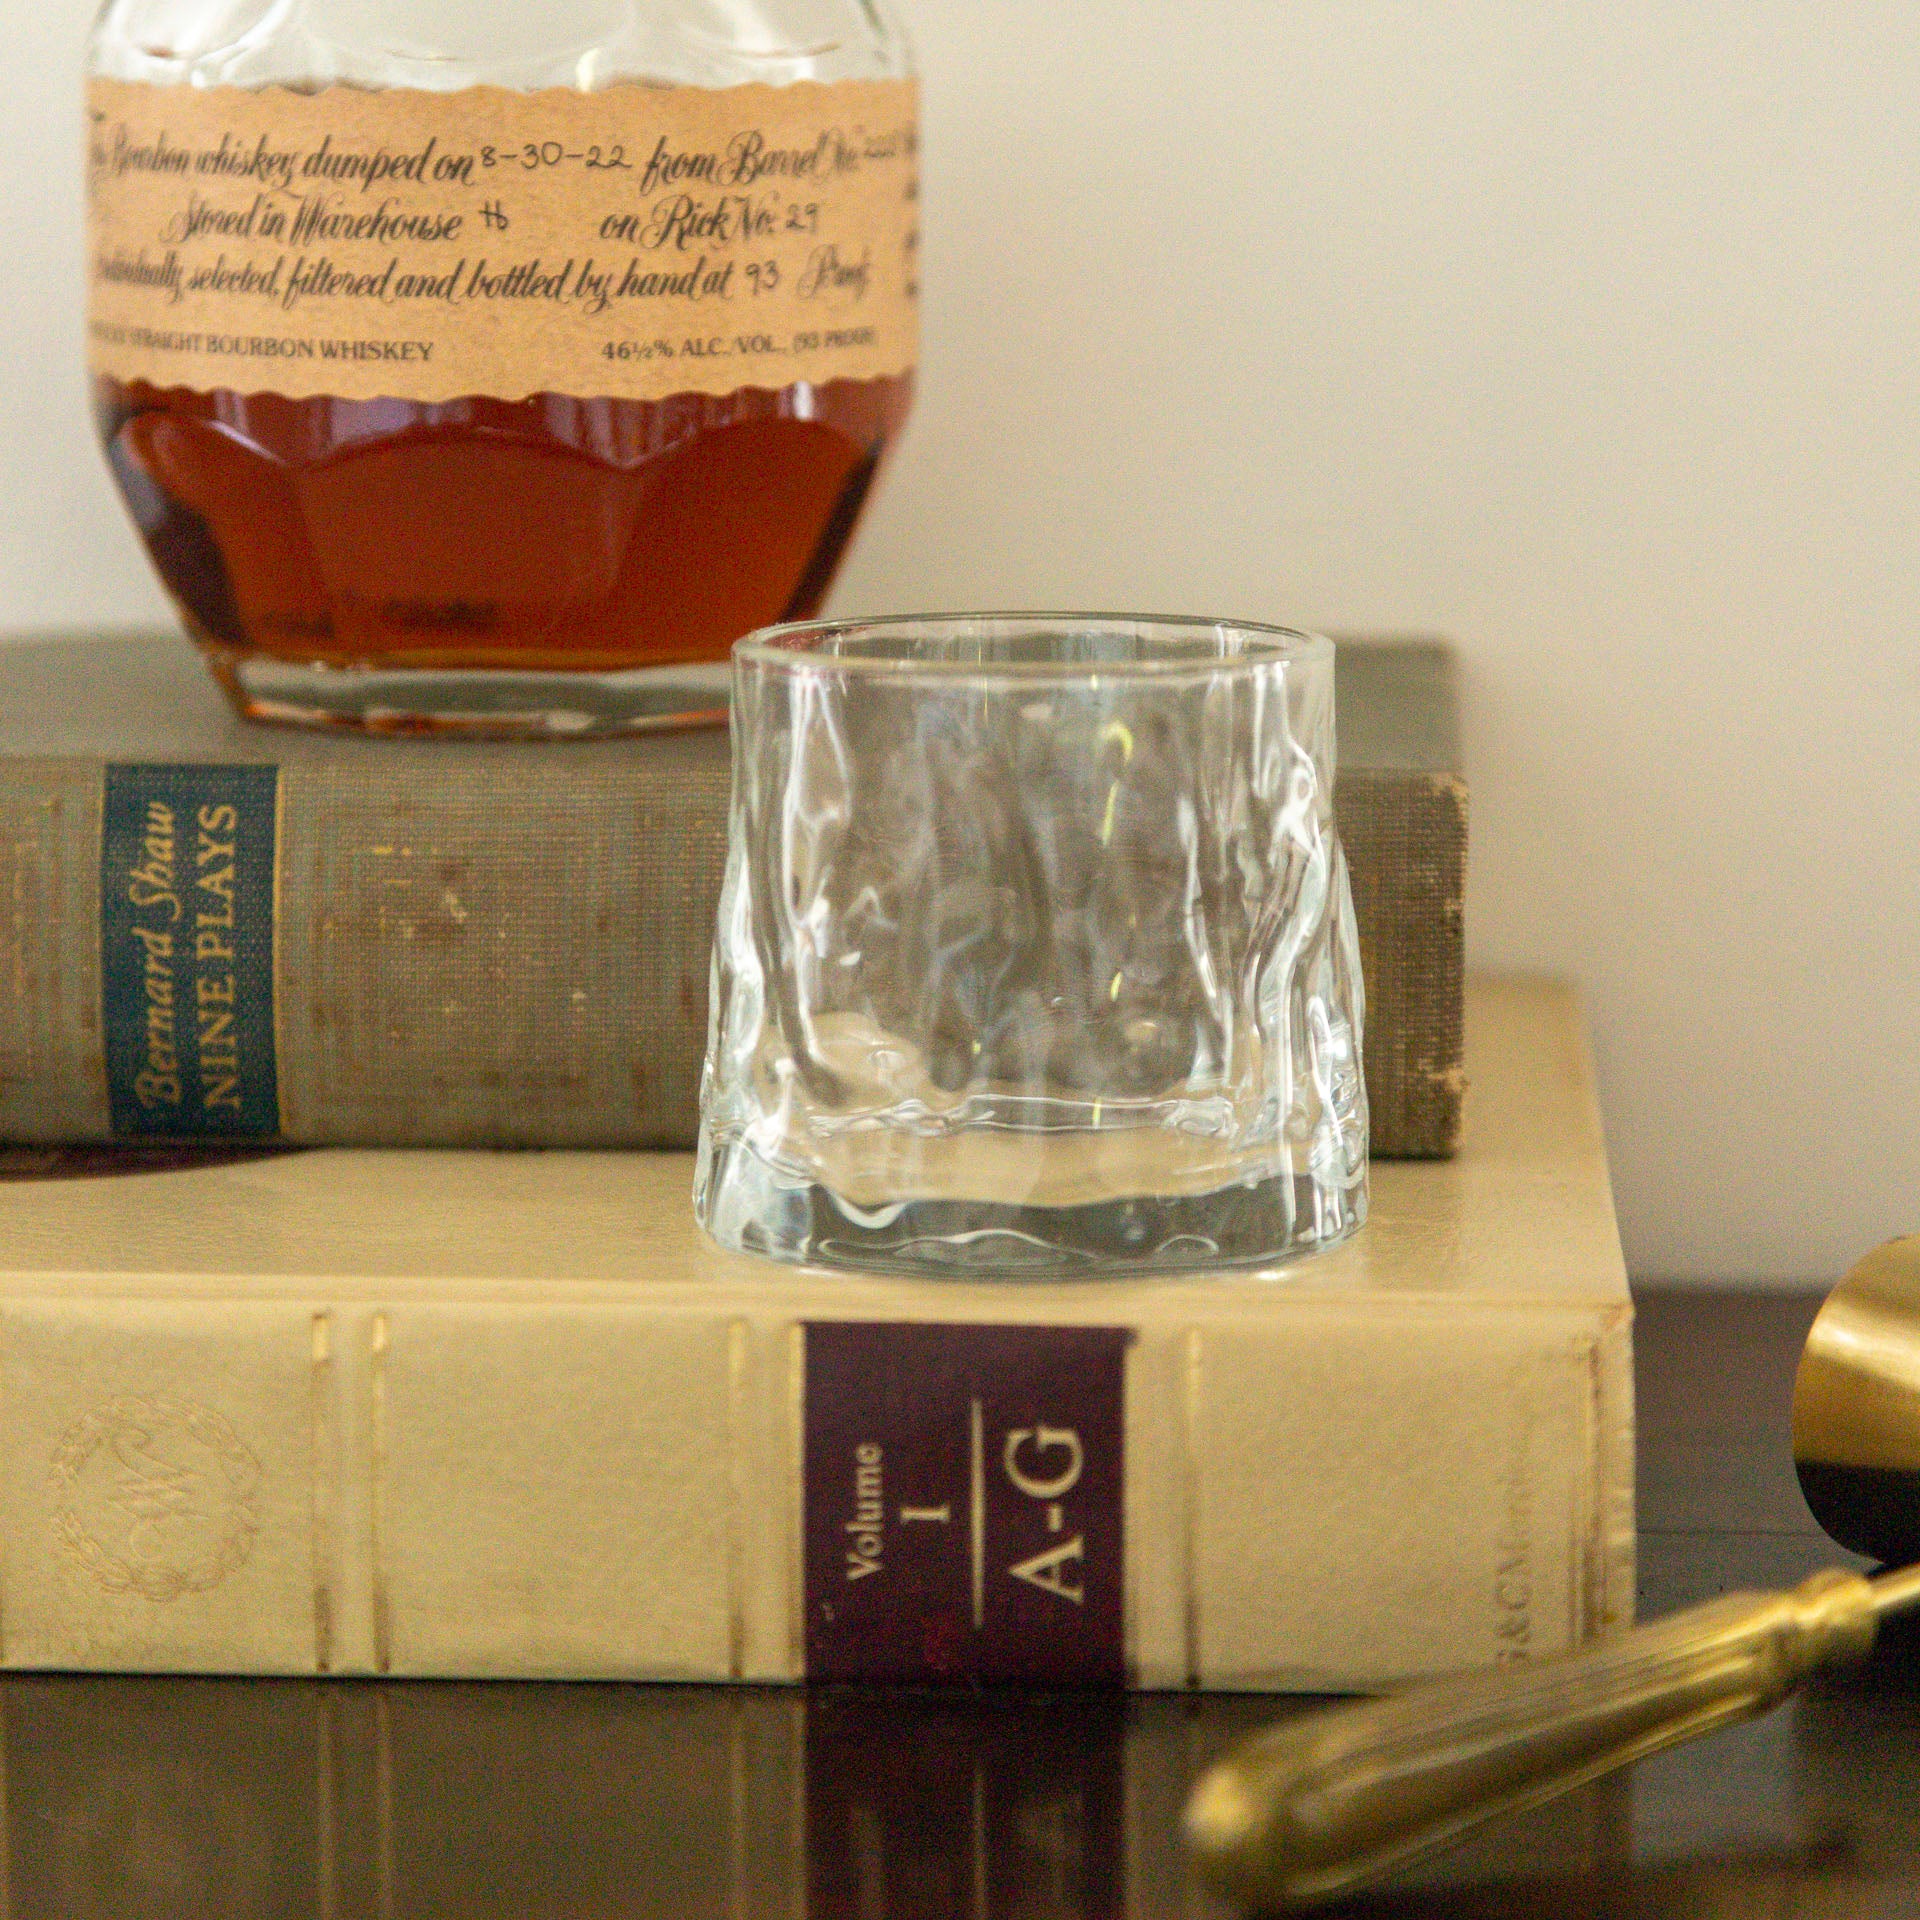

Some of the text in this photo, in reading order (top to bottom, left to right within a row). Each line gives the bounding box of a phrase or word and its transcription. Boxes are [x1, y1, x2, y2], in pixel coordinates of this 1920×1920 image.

[196, 132, 298, 190] whiskey
[302, 134, 430, 193] dumped
[432, 152, 476, 186] on
[480, 140, 633, 170] 8-30-22
[640, 134, 716, 197] from
[258, 203, 289, 237] in
[289, 191, 464, 248] Warehouse
[600, 212, 642, 244] on
[640, 194, 730, 252] Rick
[786, 202, 820, 235] 29
[186, 253, 286, 299] selected,
[280, 255, 398, 311] filtered
[394, 257, 468, 307] and
[465, 256, 572, 304] bottled
[570, 257, 617, 314] by
[614, 255, 706, 302] hand
[701, 260, 735, 300] at
[744, 260, 781, 296] 93
[206, 334, 315, 359] BOURBON
[319, 338, 435, 362] WHISKEY
[128, 801, 183, 1109] Bernard Shaw
[197, 803, 242, 1111] NINE PLAYS
[846, 1442, 885, 1581] Volume
[1003, 1425, 1084, 1605] A-G
